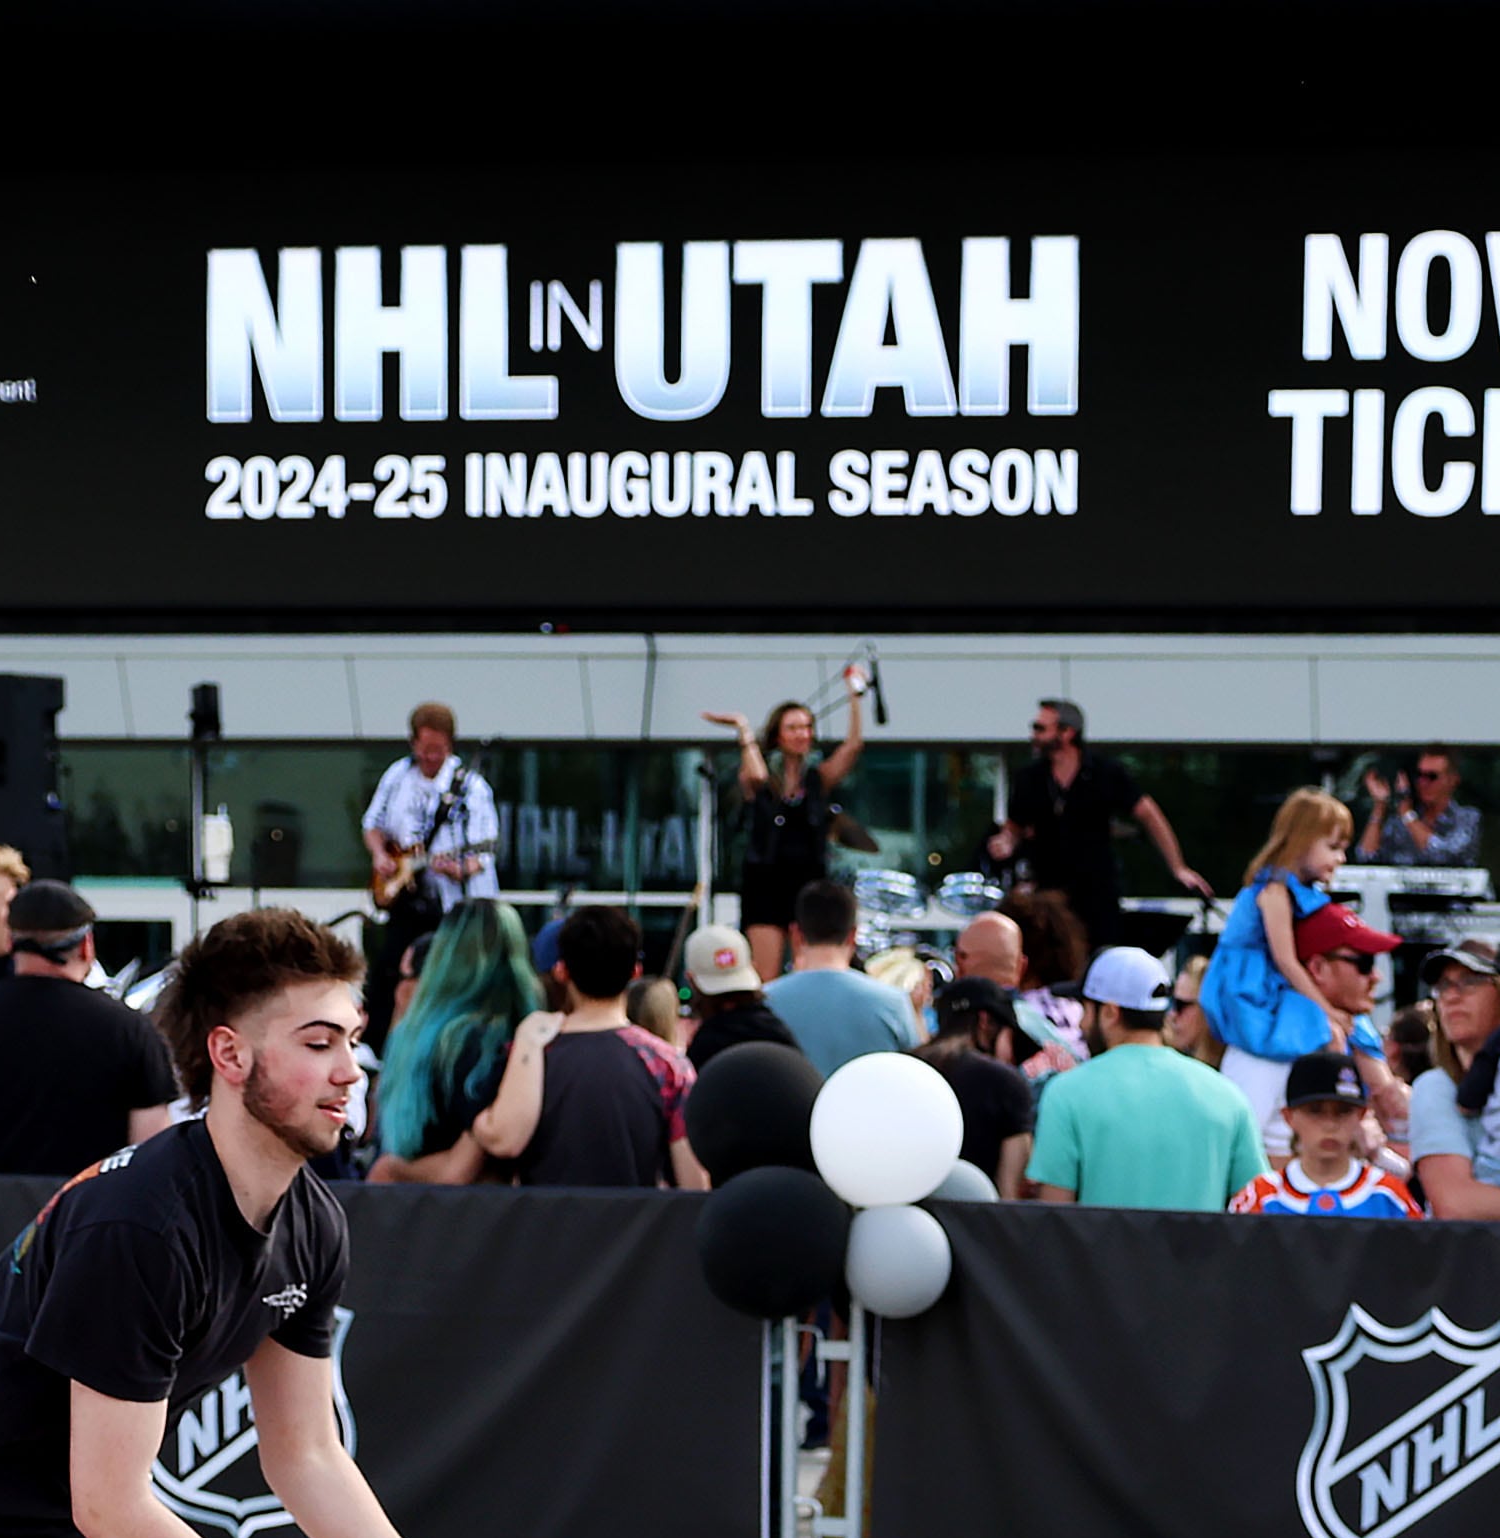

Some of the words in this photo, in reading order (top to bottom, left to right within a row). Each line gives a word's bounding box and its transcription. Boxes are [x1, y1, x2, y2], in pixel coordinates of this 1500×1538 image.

[205, 243, 560, 424] NHL
[529, 279, 603, 353] IN
[613, 234, 1080, 422] UTAH
[204, 454, 449, 521] 2024-25
[464, 450, 815, 519] INAUGURAL
[827, 447, 1079, 518] SEASON
[177, 1372, 256, 1476] NH
